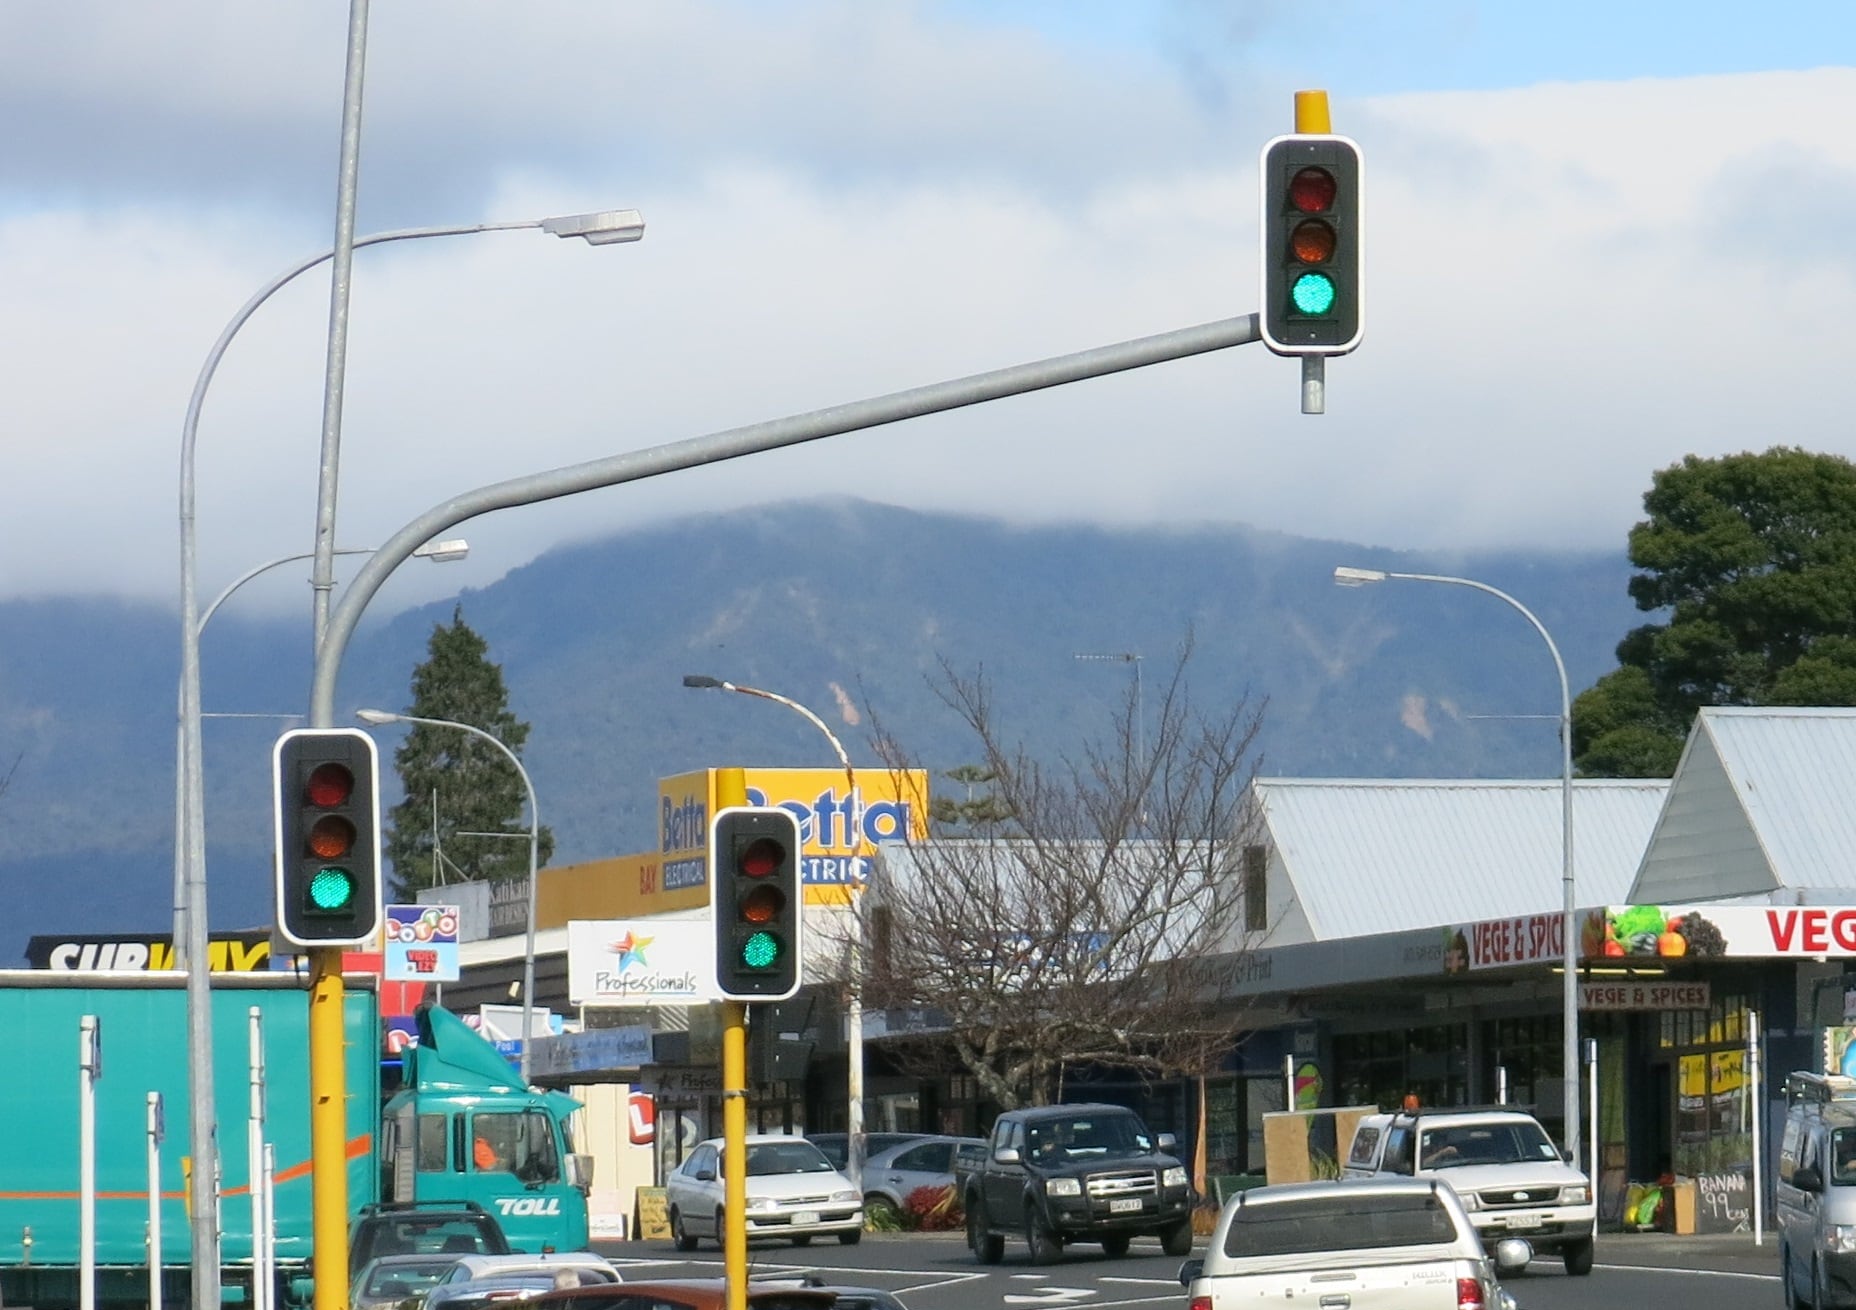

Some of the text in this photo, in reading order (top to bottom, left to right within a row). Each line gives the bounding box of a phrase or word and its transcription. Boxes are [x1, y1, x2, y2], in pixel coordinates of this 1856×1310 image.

[745, 786, 908, 848] etta
[639, 865, 657, 896] BAY
[386, 909, 457, 942] LOTTO
[1472, 923, 1511, 965] VEGE
[1513, 918, 1525, 962] &
[595, 971, 697, 997] Professionals
[1583, 986, 1706, 1005] VEGE & SPICES
[495, 1198, 560, 1215] TOLL
